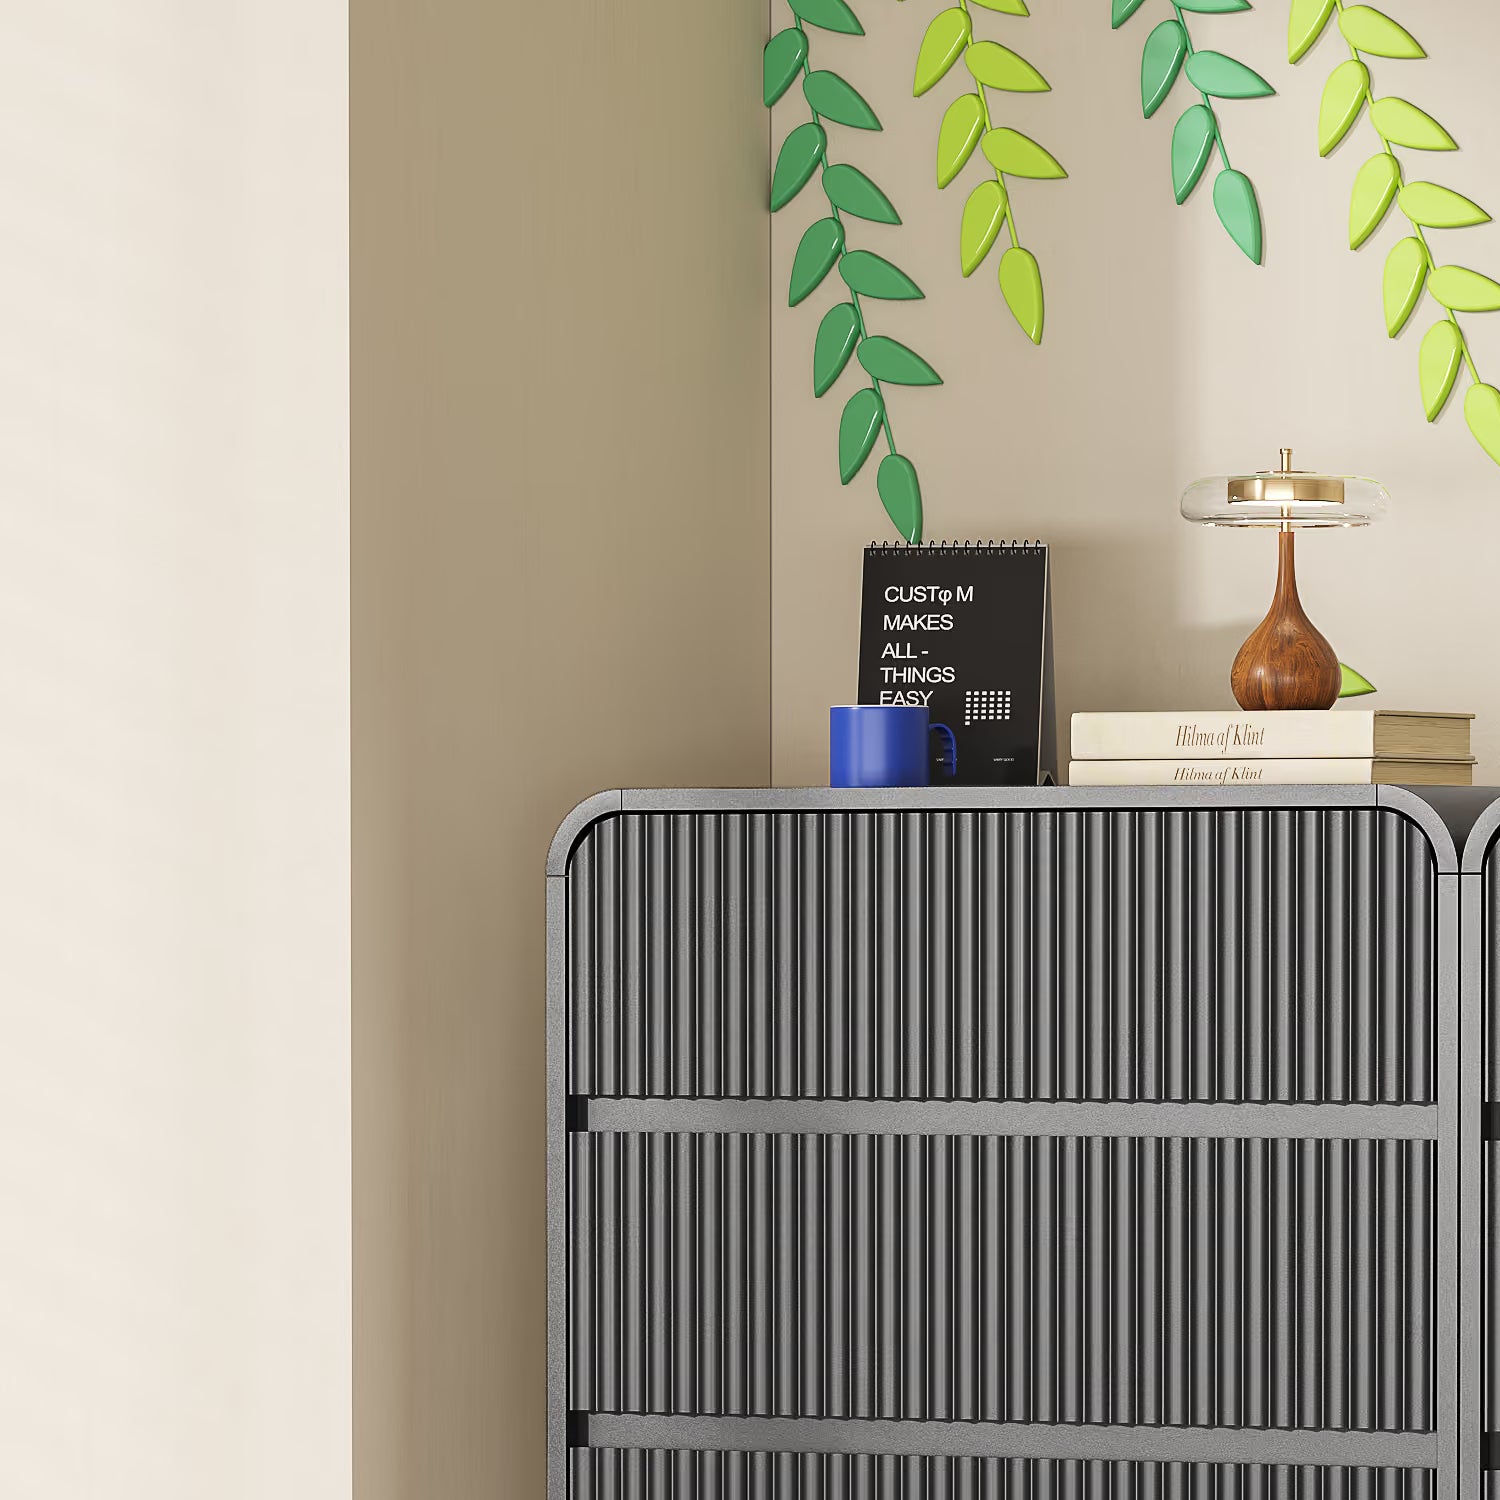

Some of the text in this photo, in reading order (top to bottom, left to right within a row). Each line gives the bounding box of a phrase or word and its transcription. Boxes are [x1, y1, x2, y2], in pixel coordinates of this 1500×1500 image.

[883, 613, 954, 631] MAKES
[880, 666, 956, 683] THINGS
[880, 690, 934, 706] EASY
[1175, 724, 1265, 755] Hilma af Klint
[1174, 767, 1213, 780] Hilma
[1231, 766, 1263, 780] Klint
